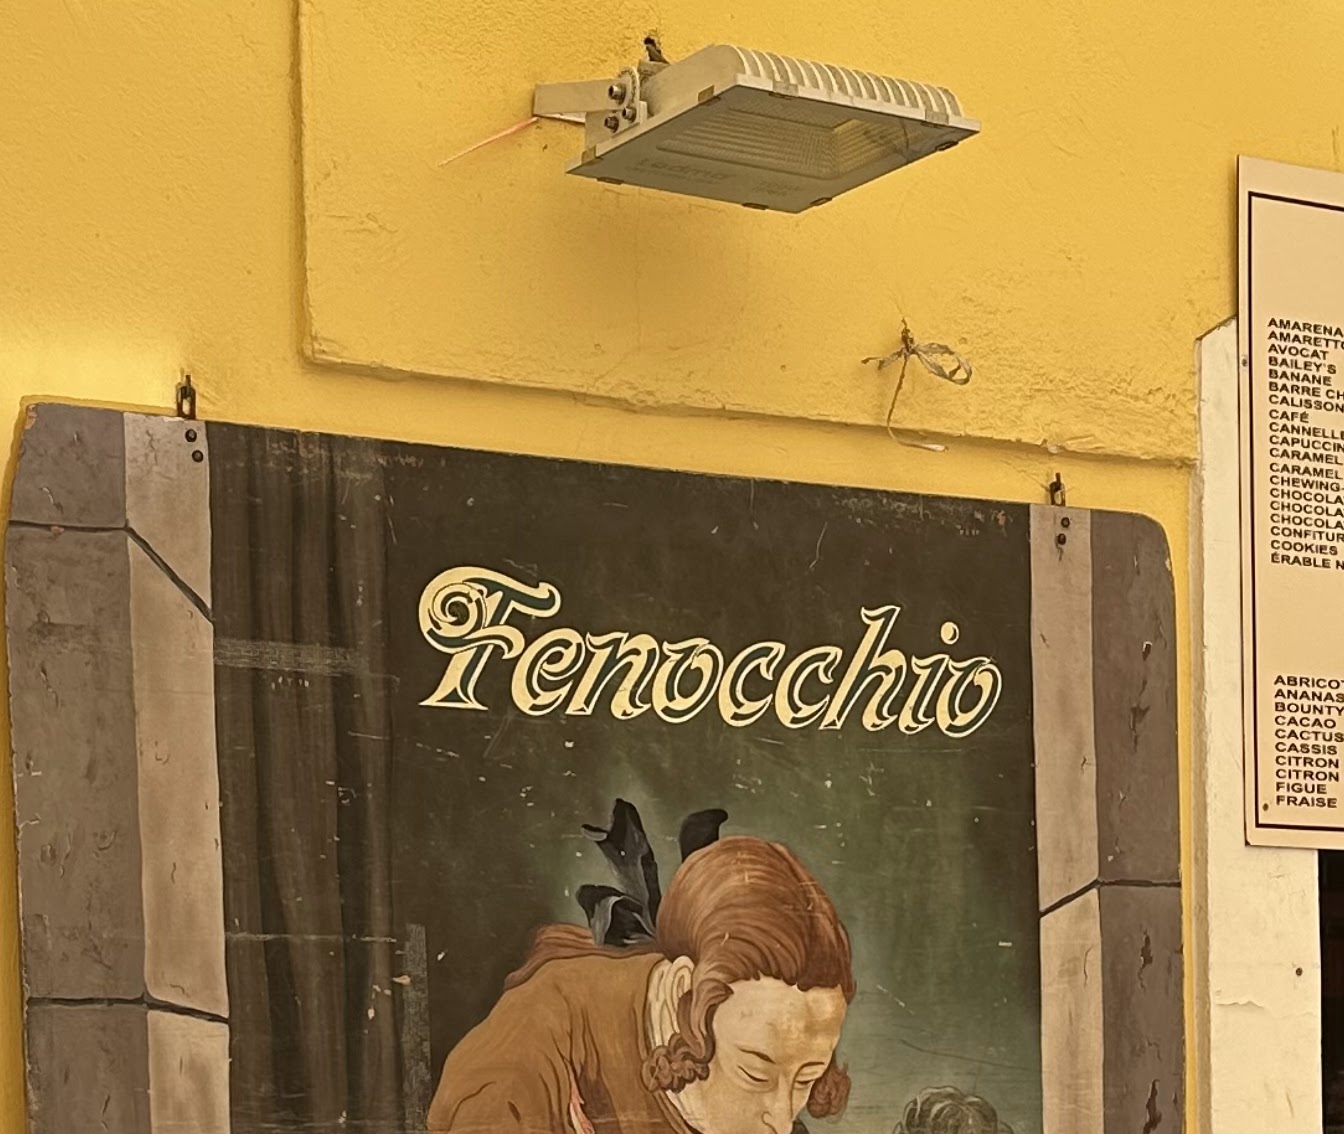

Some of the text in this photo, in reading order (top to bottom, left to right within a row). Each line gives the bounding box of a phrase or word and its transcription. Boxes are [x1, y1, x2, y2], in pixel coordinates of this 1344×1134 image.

[1267, 318, 1344, 337] AMARENA
[1268, 344, 1329, 360] AVOCAT
[1268, 356, 1337, 374] BAILEY'S
[1268, 369, 1332, 386] BANANE
[1269, 381, 1321, 397] BARRE
[1269, 395, 1344, 413] CALISSON
[1269, 409, 1309, 424] CAFÉ
[1269, 448, 1344, 465] CARAMEL
[1270, 540, 1338, 555] COOKIES
[417, 565, 1003, 738] Fenocchio
[1274, 702, 1344, 716] BOUNTY
[1274, 715, 1336, 729] CACAO
[1275, 729, 1344, 742] CACTUS
[1275, 742, 1338, 755] CASSIS
[1275, 755, 1339, 768] CITRON
[1276, 769, 1339, 782] CITRON
[1276, 782, 1327, 794] FIGUE
[1276, 795, 1337, 808] FRAISE
